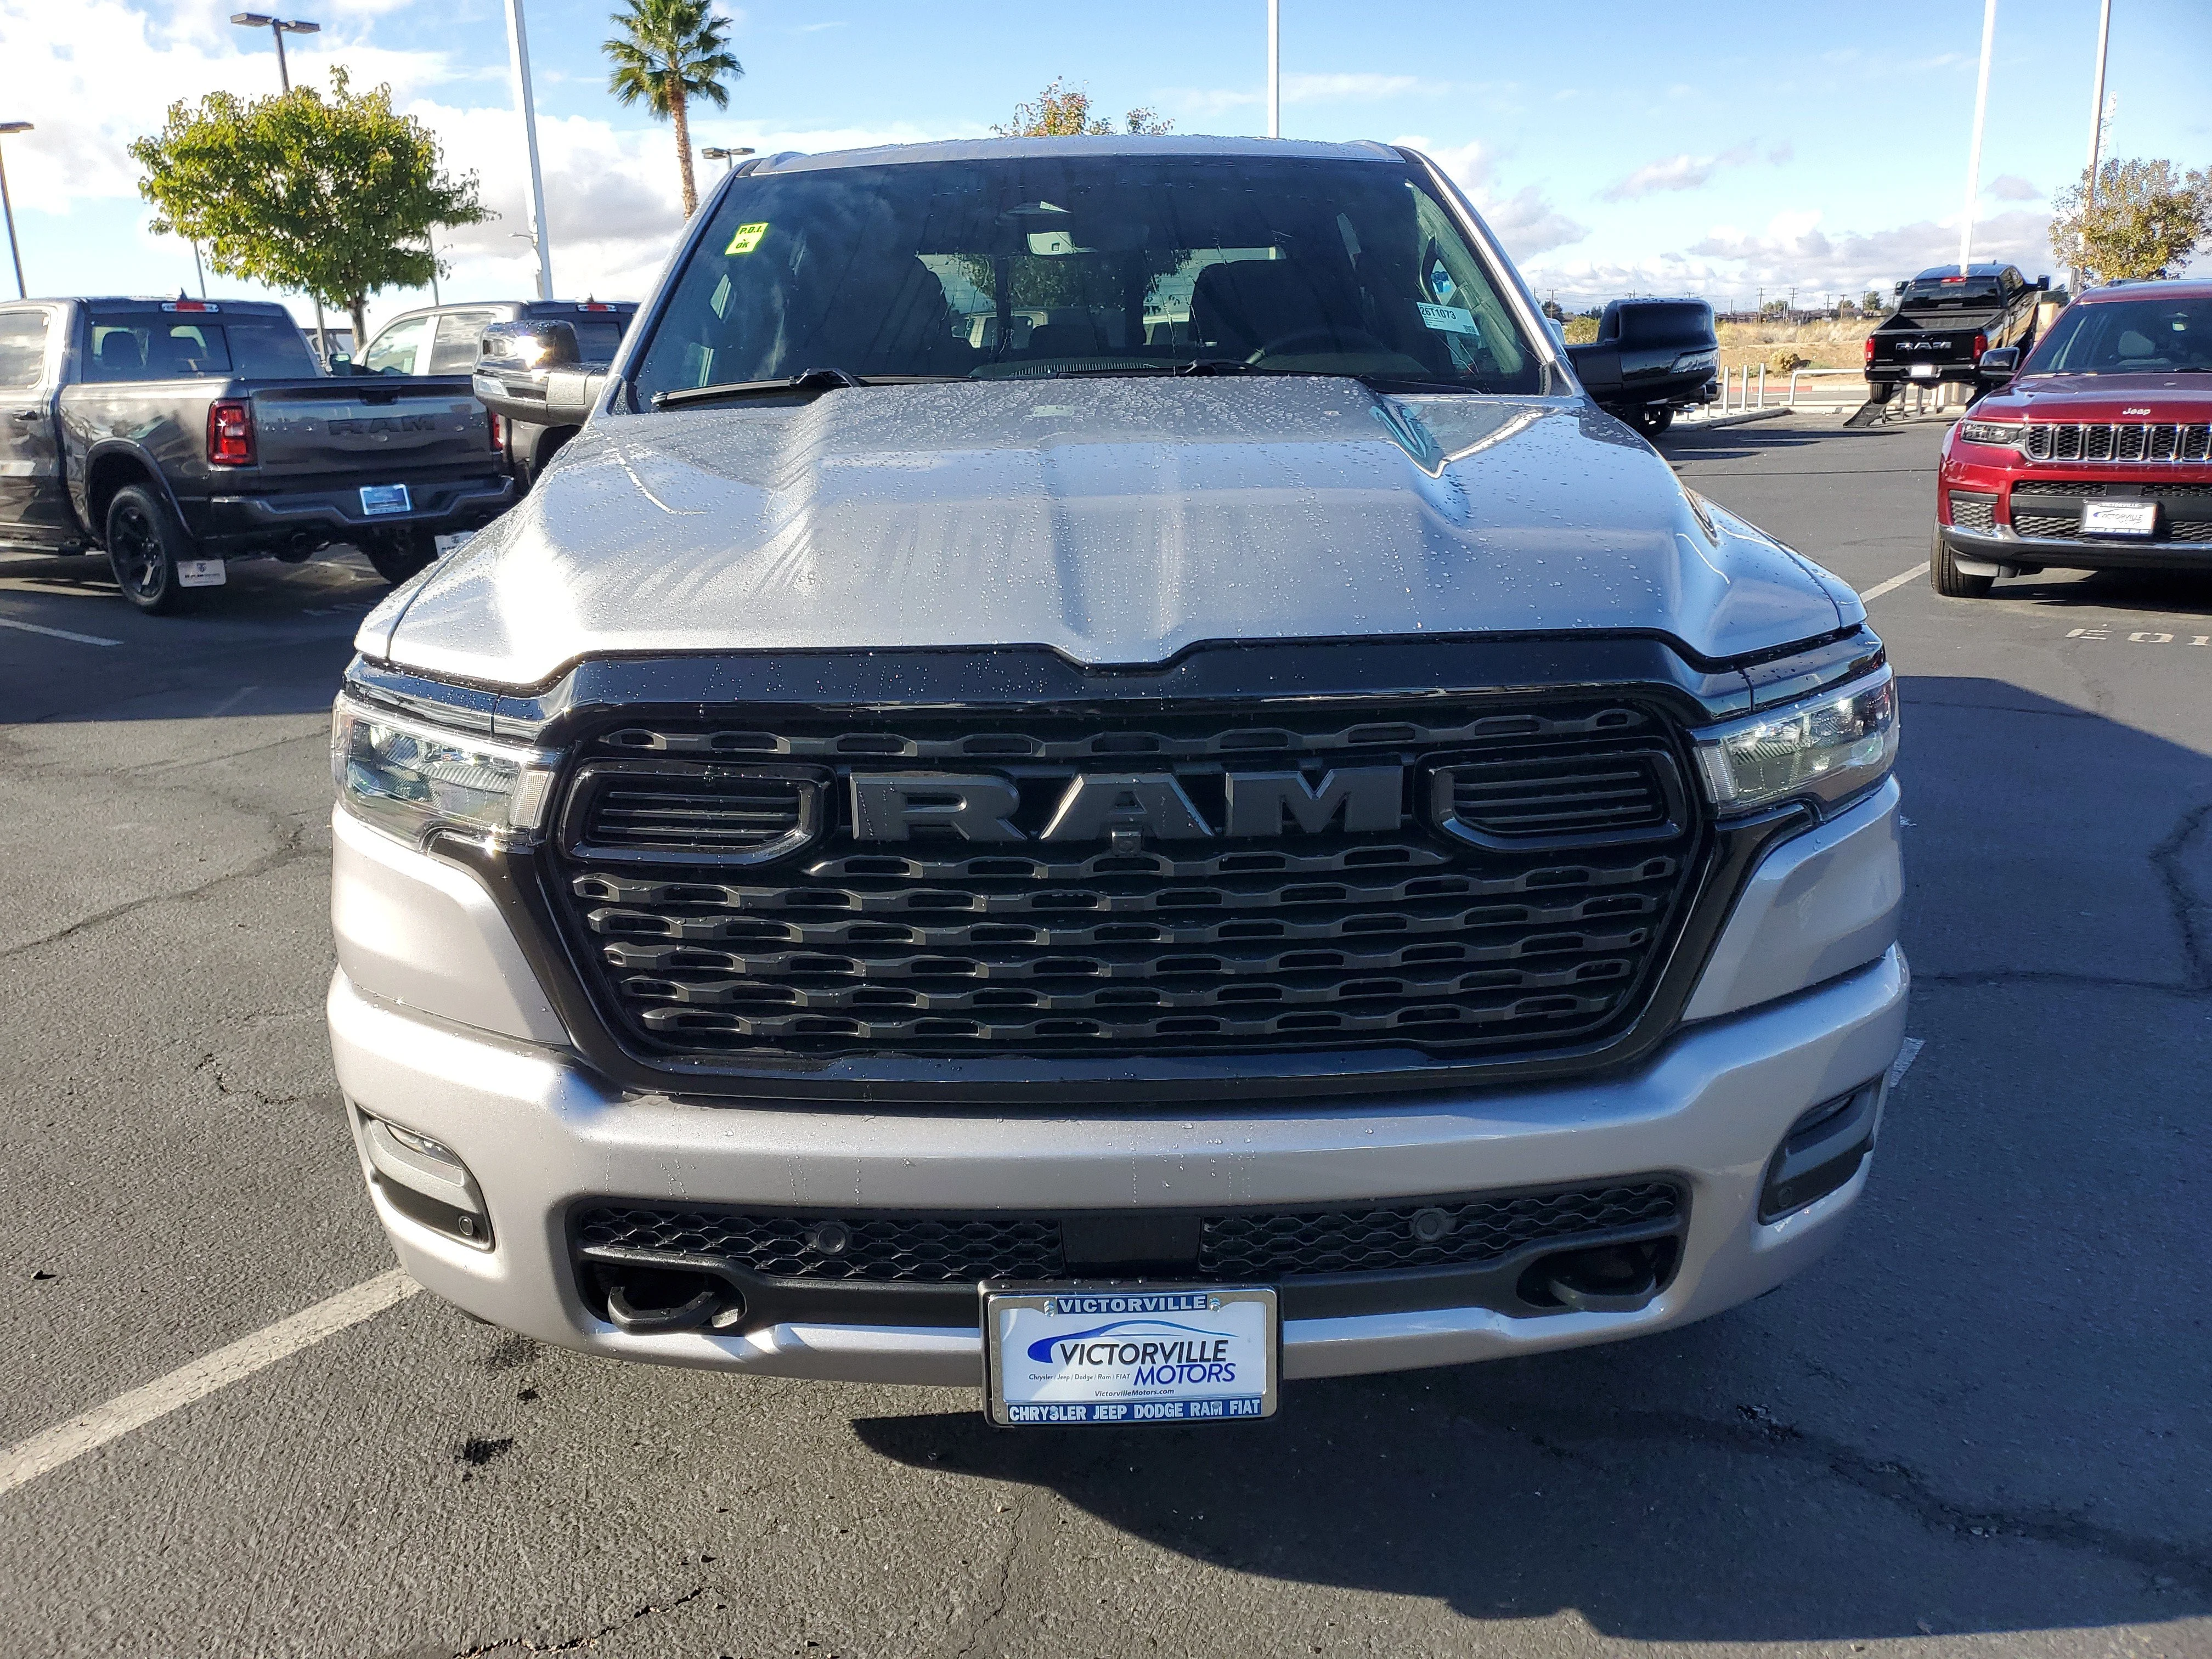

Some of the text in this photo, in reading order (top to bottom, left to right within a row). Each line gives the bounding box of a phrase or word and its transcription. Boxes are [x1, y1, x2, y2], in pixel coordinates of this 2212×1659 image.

[739, 225, 762, 234] P.D.I.
[1419, 307, 1457, 320] 26T1073
[1895, 341, 1952, 350] RAM
[329, 416, 436, 435] RAM
[850, 766, 1403, 840] RAM
[1059, 1296, 1206, 1313] VICTORVILLE
[1059, 1340, 1229, 1365] VICTORVILLE
[1133, 1362, 1236, 1386] MOTORS
[1094, 1388, 1175, 1397] VictorvilleMotors.com
[1093, 1404, 1127, 1420] JEEP
[1134, 1403, 1183, 1419] DODGE
[1190, 1401, 1223, 1417] RAM
[1229, 1400, 1260, 1415] FIAT
